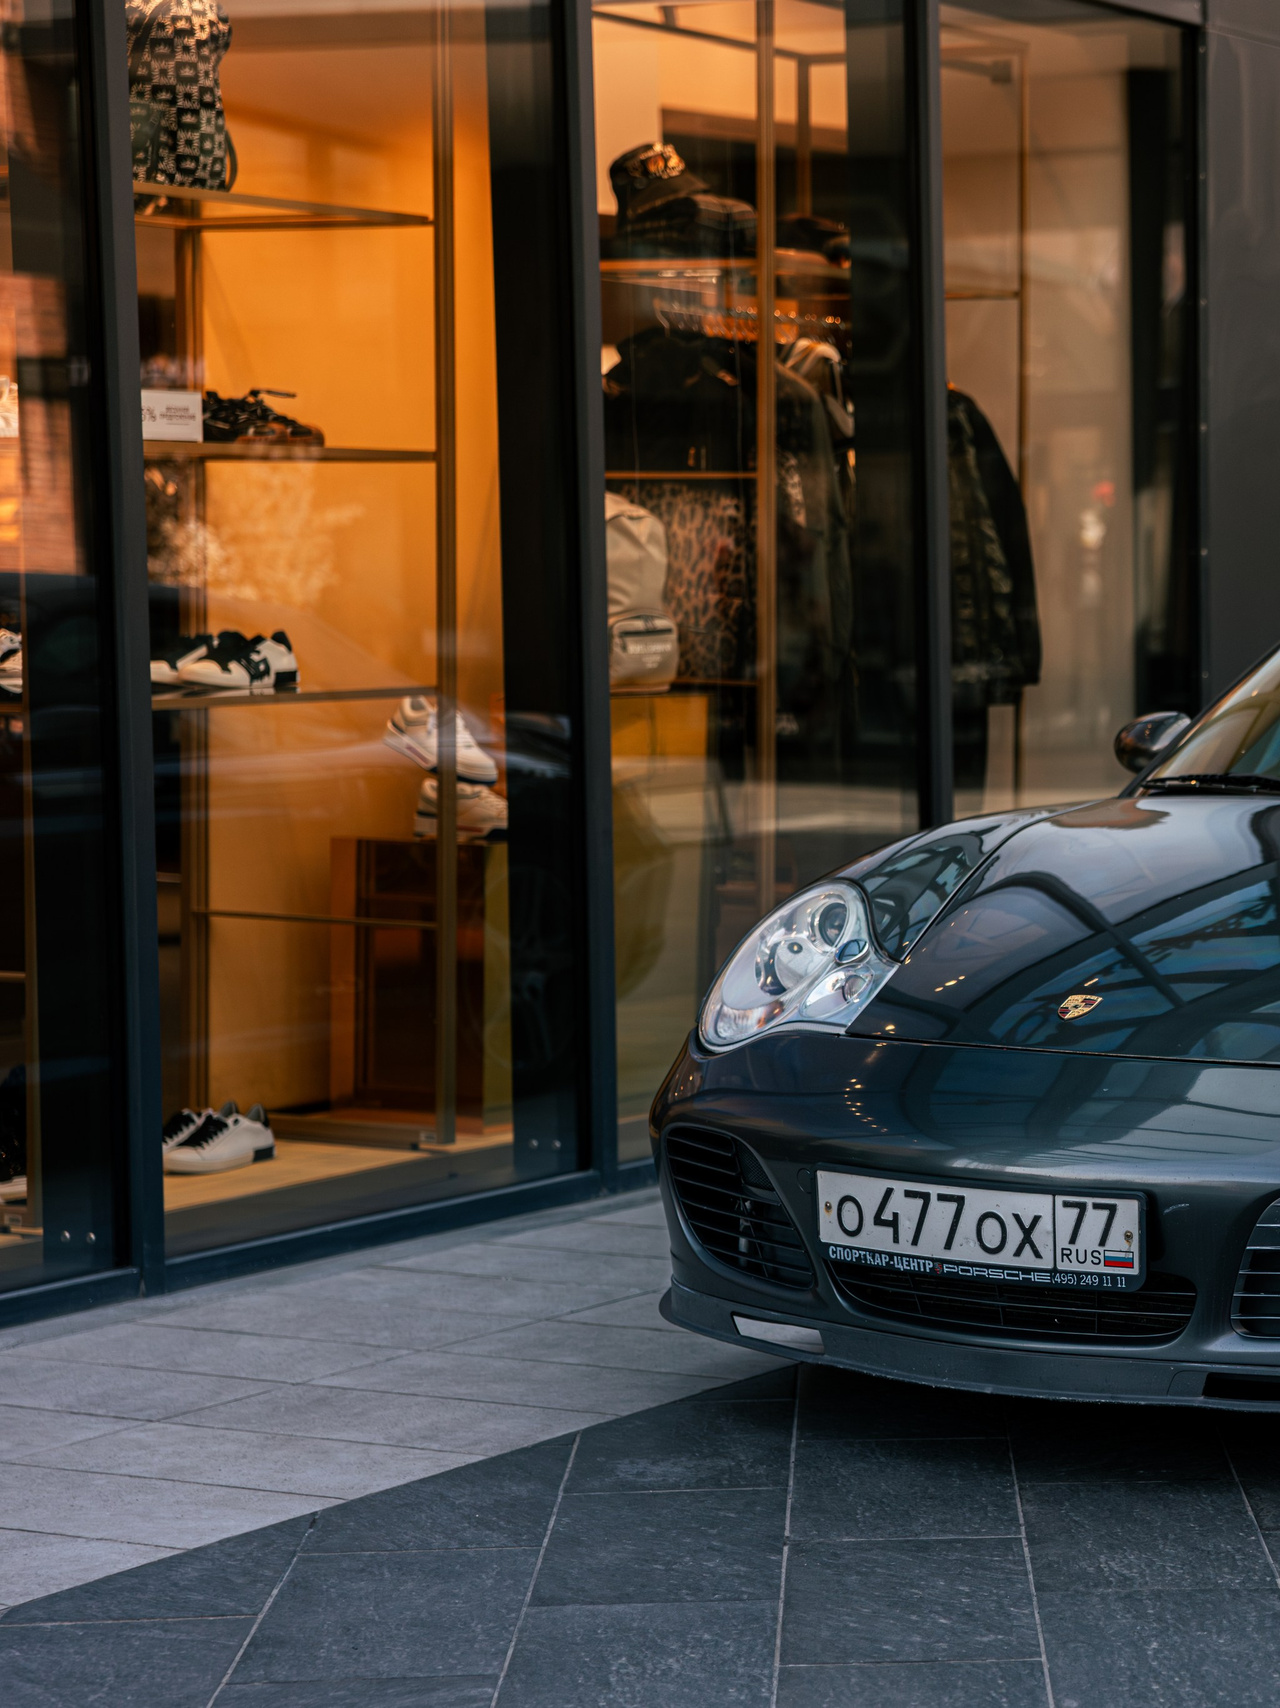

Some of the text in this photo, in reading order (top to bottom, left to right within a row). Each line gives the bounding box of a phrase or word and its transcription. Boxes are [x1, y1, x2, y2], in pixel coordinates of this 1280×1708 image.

[1062, 1200, 1118, 1248] 77
[828, 1245, 1127, 1288] СПОРТКАР-ЦЕНТР PORSCHE (495) 249 11 11
[1060, 1247, 1102, 1266] RUS
